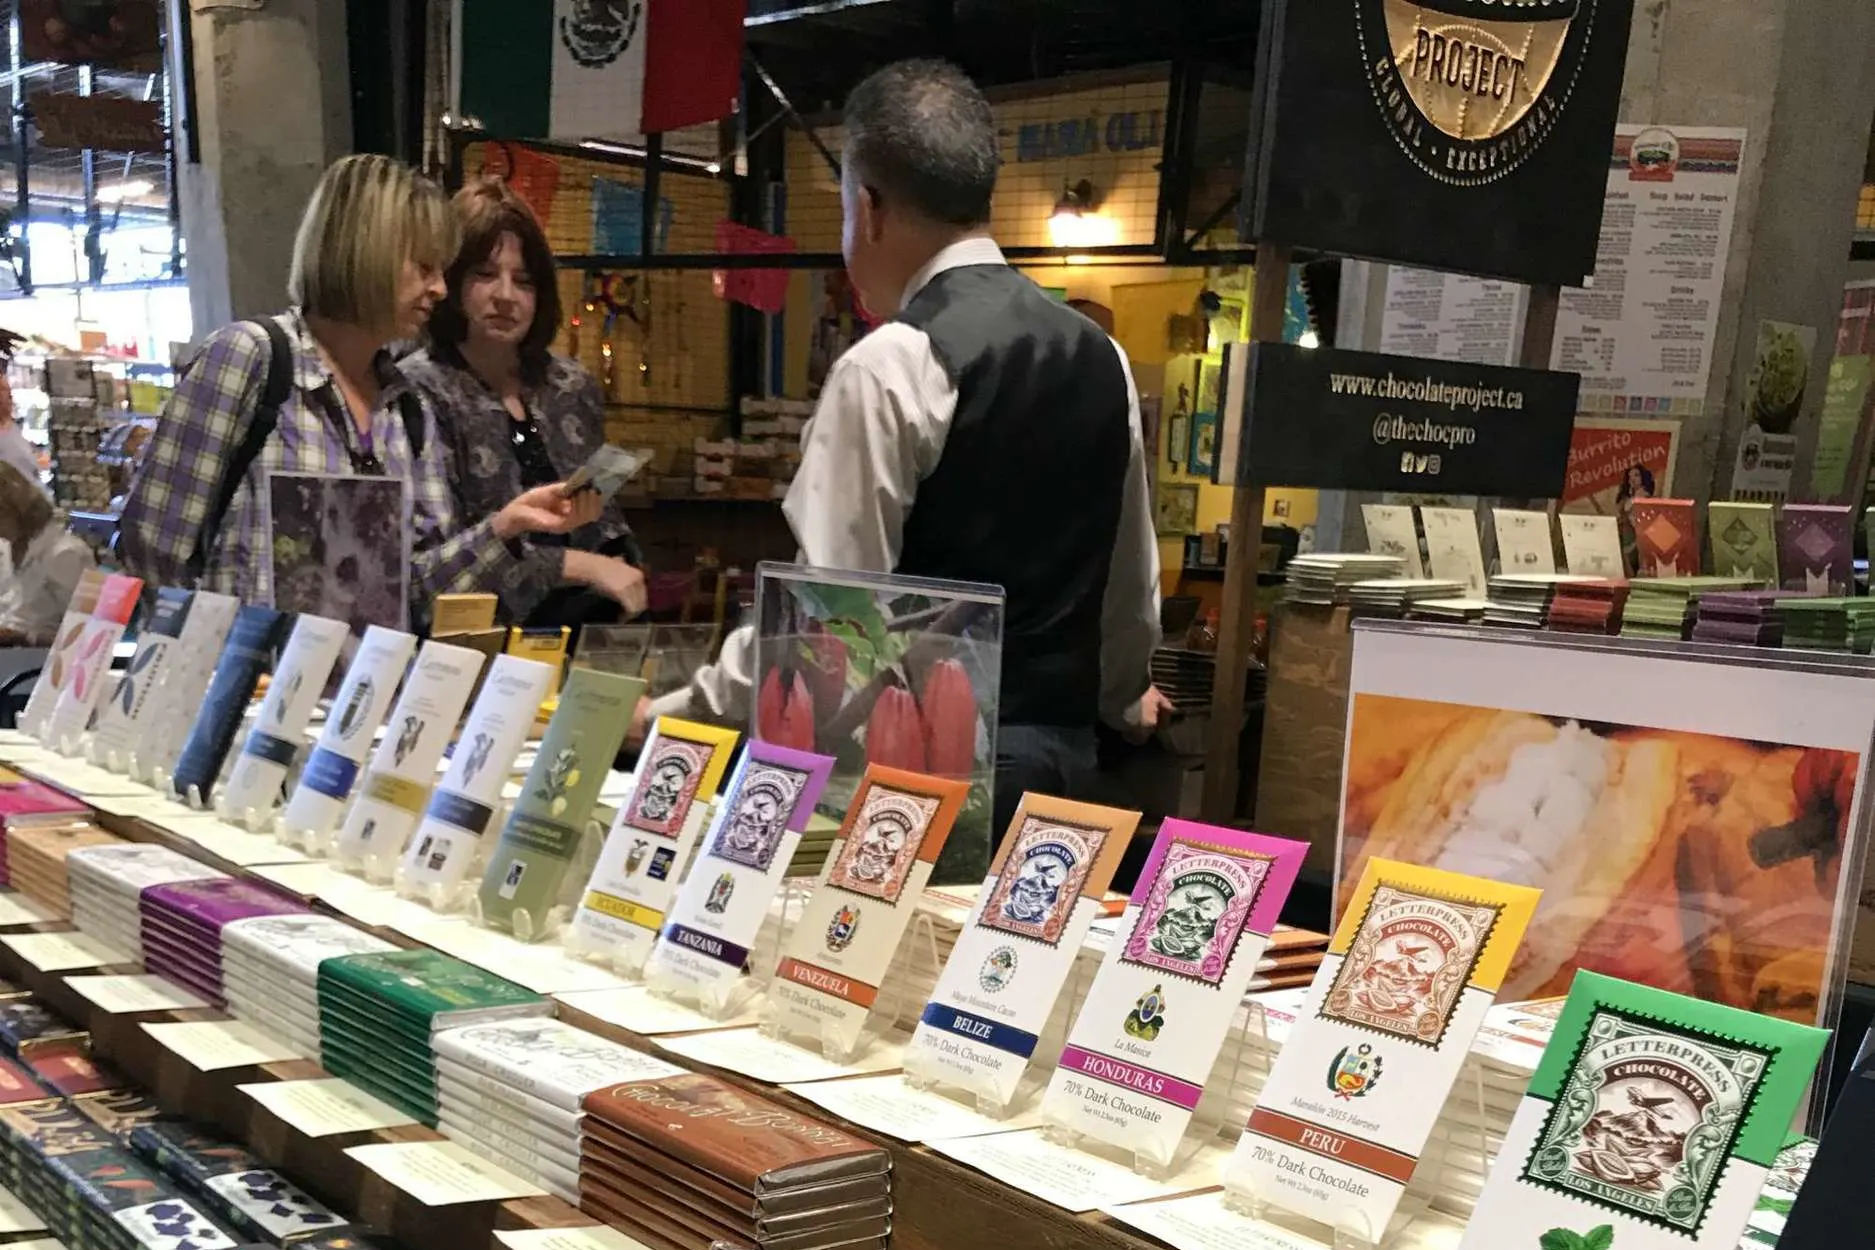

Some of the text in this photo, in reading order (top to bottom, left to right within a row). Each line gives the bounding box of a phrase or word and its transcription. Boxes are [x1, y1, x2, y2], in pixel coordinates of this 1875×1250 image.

[1410, 28, 1525, 103] PROJECT
[1446, 96, 1556, 171] EXCEPTIONAL
[1330, 372, 1523, 412] www.chocolateproject.ca
[1373, 412, 1476, 449] @thechocpro
[1569, 443, 1667, 490] Revolution
[1172, 859, 1246, 890] LETTERPRESS
[1178, 874, 1233, 897] CHOCOLATE
[1380, 904, 1469, 940] LETTERPRESS
[1387, 921, 1452, 947] CHOCOLATE
[676, 929, 723, 957] TANZANIA
[792, 964, 849, 996] VENEZUELA
[952, 1015, 993, 1039] BELIZE
[940, 1039, 960, 1056] Dark
[960, 1046, 1002, 1070] Chocolate
[1602, 1039, 1731, 1094] LETTERPRESS
[1083, 1056, 1164, 1094] HONDURAS
[1613, 1061, 1707, 1102] CHOCOLATE
[1064, 1079, 1162, 1124] 70% Dark Chocolate
[1327, 1107, 1347, 1122] 2015
[1300, 1128, 1346, 1155] PERU
[1251, 1146, 1369, 1198] 70% Dark Chocolate
[1568, 1175, 1654, 1210] LOS ANGELES
